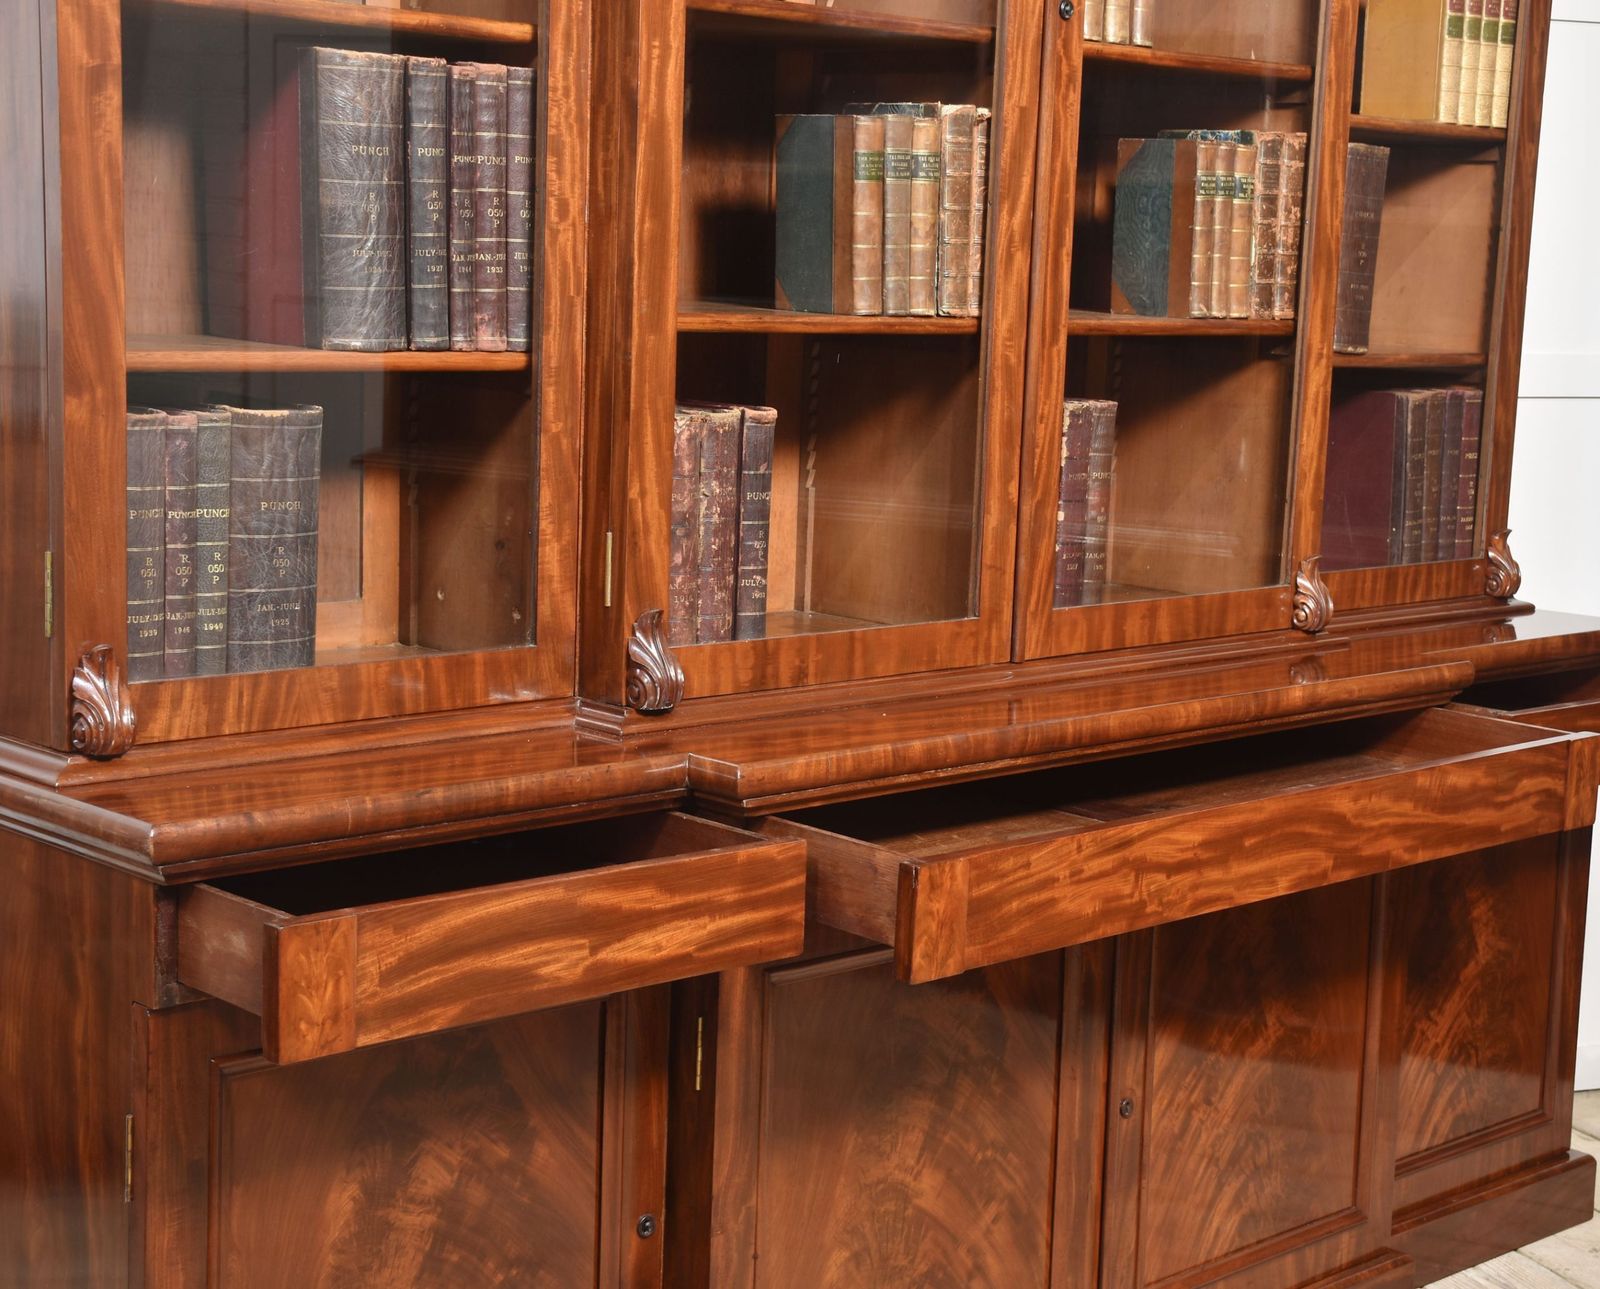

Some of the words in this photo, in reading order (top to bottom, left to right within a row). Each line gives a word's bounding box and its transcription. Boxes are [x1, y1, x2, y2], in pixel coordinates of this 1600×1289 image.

[352, 146, 389, 157] PUNCH
[370, 192, 376, 201] R
[432, 190, 439, 199] R
[427, 201, 443, 210] 050
[464, 199, 470, 207] R
[493, 197, 500, 206] R
[433, 213, 439, 221] P
[488, 209, 503, 217] 050
[371, 214, 377, 223] P
[494, 219, 500, 227] P
[487, 266, 503, 274] 1933
[261, 501, 301, 511] PUNCH
[197, 508, 229, 518] PUNCH
[759, 530, 765, 538] R
[278, 546, 285, 555] R
[181, 554, 189, 563] R
[214, 551, 221, 561] R
[147, 557, 153, 566] R
[273, 558, 289, 568] 050
[141, 568, 157, 577] 050
[175, 566, 192, 575] 050
[207, 564, 224, 573] 050
[279, 569, 285, 577] P
[146, 579, 153, 589] P
[181, 577, 188, 587] P
[213, 575, 219, 584] P
[271, 617, 289, 626] 1925
[139, 629, 157, 638] 1939
